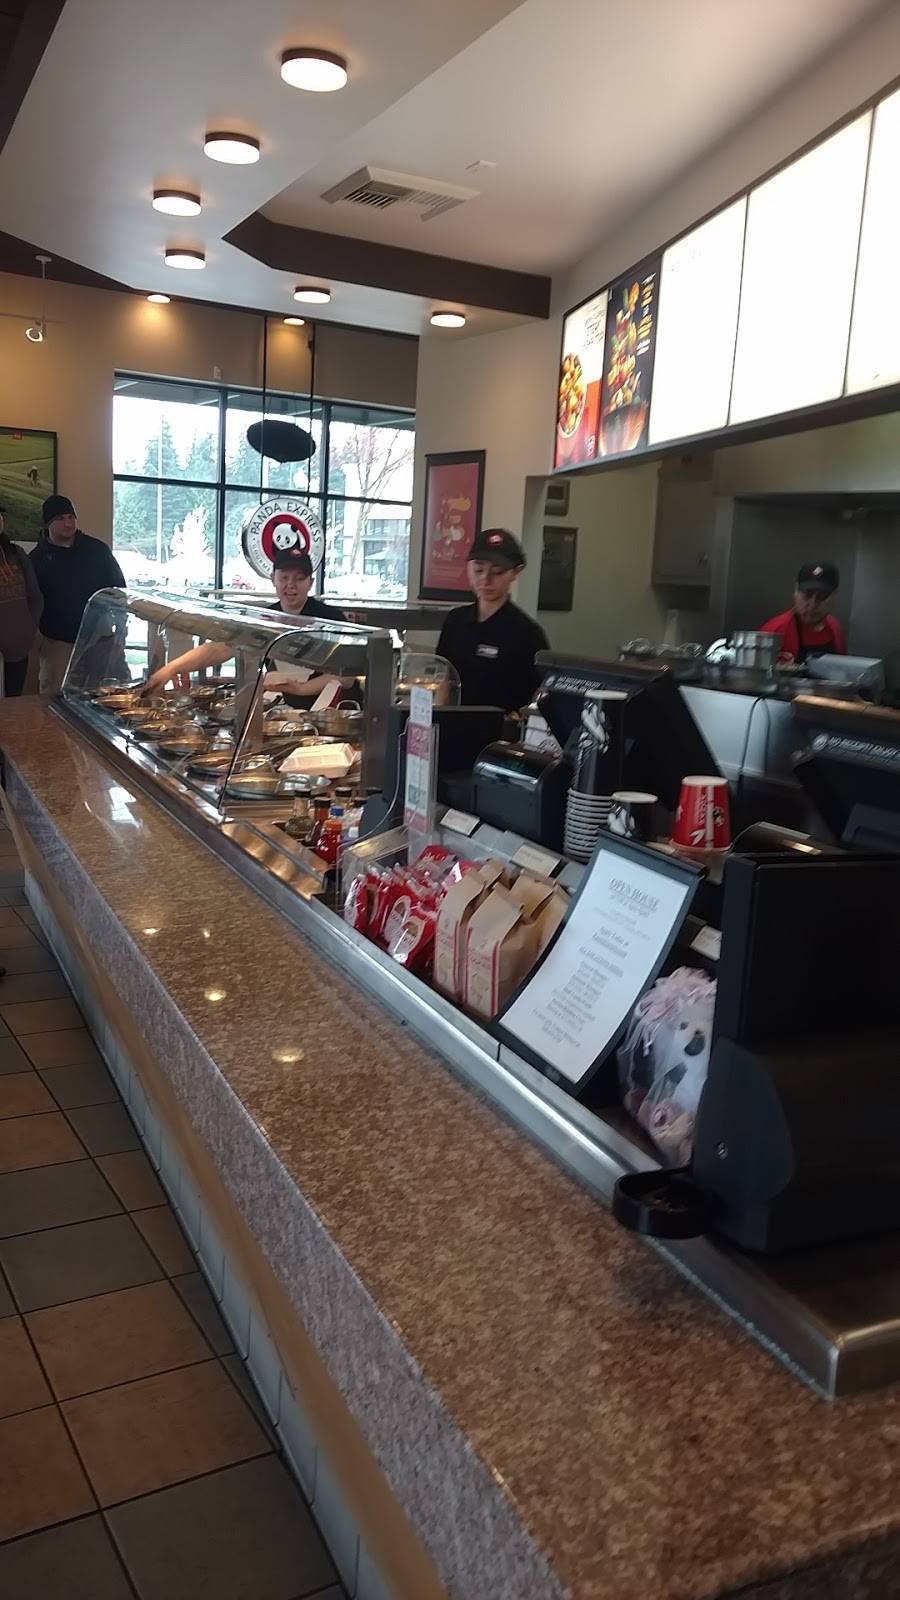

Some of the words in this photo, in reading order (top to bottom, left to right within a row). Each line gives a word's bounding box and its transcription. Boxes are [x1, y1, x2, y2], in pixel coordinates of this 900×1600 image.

[250, 502, 282, 535] PANDA
[286, 502, 321, 543] EXPRESS
[609, 878, 631, 897] OPEN
